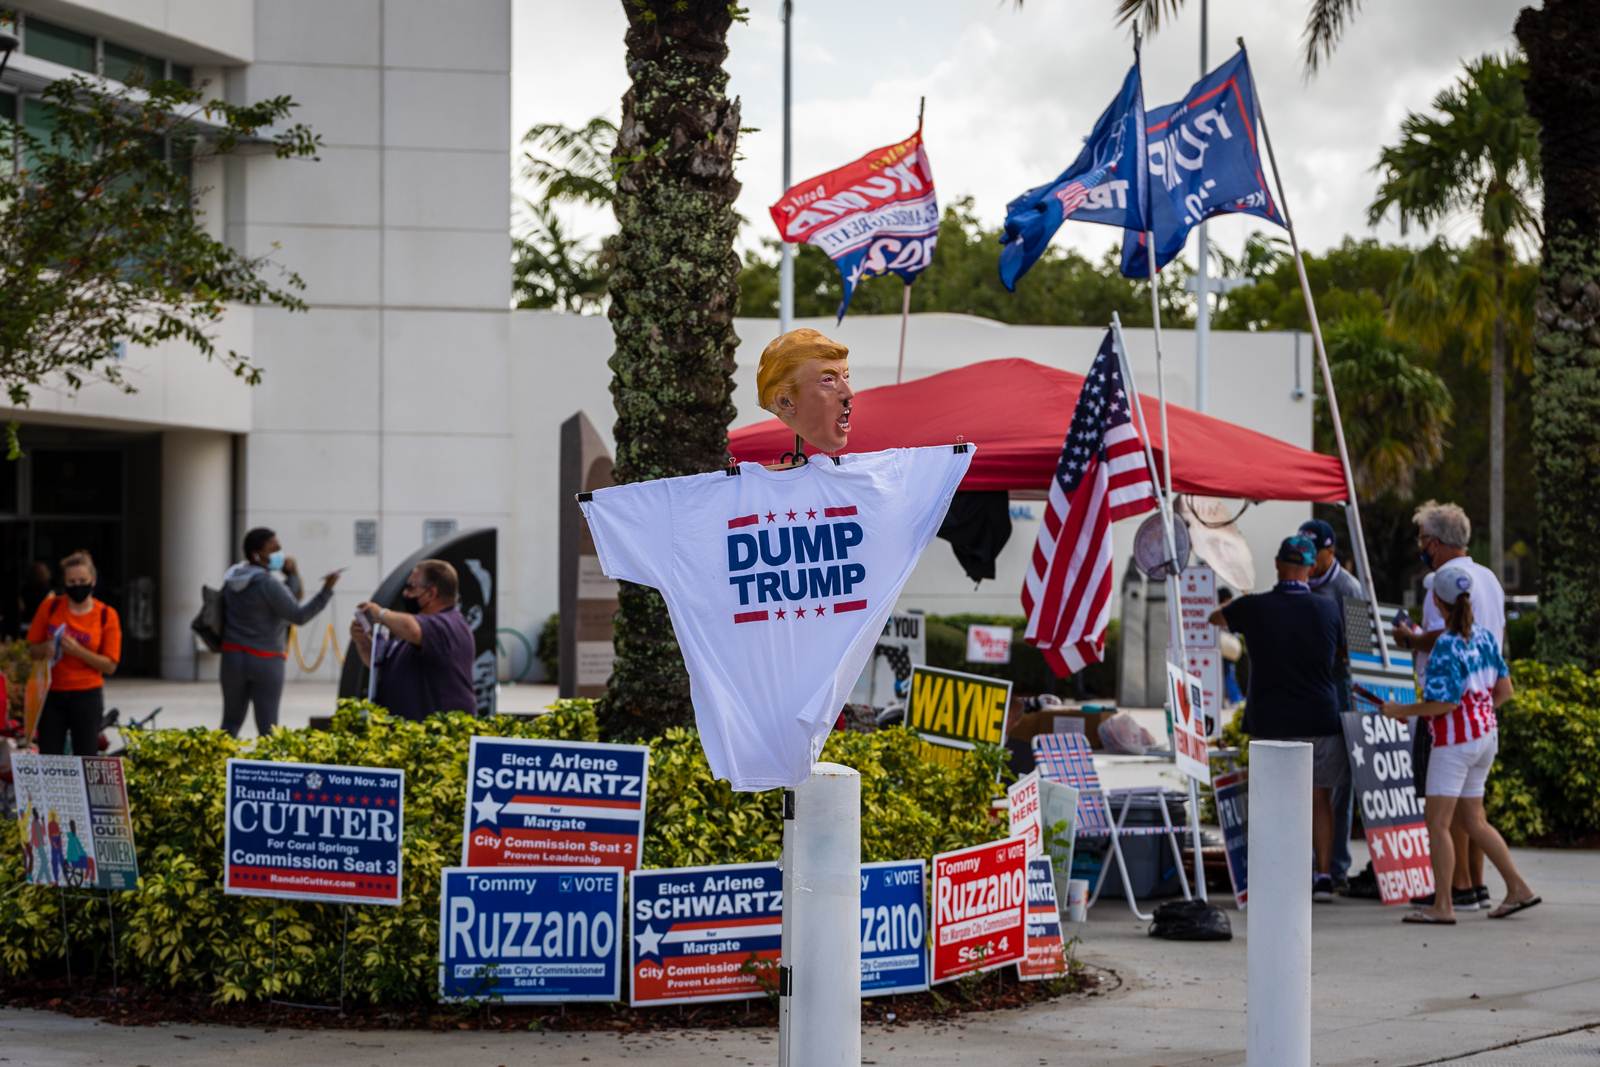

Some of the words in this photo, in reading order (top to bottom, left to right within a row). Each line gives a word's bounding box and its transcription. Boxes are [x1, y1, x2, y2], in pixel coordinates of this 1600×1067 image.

[727, 521, 864, 572] DUMP
[729, 563, 866, 606] TRUMP
[893, 617, 919, 639] YOU
[912, 672, 1007, 744] WAYNE
[1362, 714, 1411, 747] SAVE
[17, 767, 38, 775] YOU
[41, 768, 80, 777] VOTED!
[502, 753, 542, 767] Elect
[549, 752, 618, 771] Arlene
[1373, 750, 1413, 782] OUR
[328, 774, 352, 786] Vote
[354, 777, 377, 787] Nov.
[379, 777, 398, 788] 3rd
[475, 767, 641, 796] SCHWARTZ
[235, 785, 291, 802] Randal
[1011, 782, 1038, 806] VOTE
[1362, 787, 1425, 820] COUNT
[232, 800, 397, 843] CUTTER
[1012, 797, 1039, 825] HERE
[523, 815, 586, 831] Margate
[267, 838, 285, 849] For
[287, 840, 316, 851] Coral
[318, 842, 360, 855] Springs
[474, 835, 501, 849] City
[505, 836, 586, 851] Commission
[590, 841, 620, 853] Seat
[624, 843, 633, 854] 2
[1385, 825, 1430, 861] VOTE
[232, 849, 339, 871] Commission
[343, 857, 382, 873] Seat
[386, 860, 397, 875] 3
[503, 851, 540, 861] Proven
[542, 852, 602, 865] Leadership
[939, 856, 981, 876] Tommy
[1007, 844, 1025, 859] VOTE
[270, 874, 356, 888] RandalCutter.com
[467, 875, 537, 895] Tommy
[575, 877, 613, 892] VOTE
[658, 882, 695, 895] Elect
[703, 876, 765, 893] Arlene
[894, 870, 920, 886] VOTE
[1378, 868, 1435, 902] REPUBLI
[636, 890, 783, 920] SCHWARTZ
[937, 868, 1025, 925] Ruzzano
[449, 896, 614, 959] Ruzzano
[683, 940, 740, 954] Margate
[997, 936, 1009, 952] 4
[456, 967, 472, 976] For
[514, 966, 533, 977] City
[535, 965, 603, 976] Commissioner
[639, 967, 664, 978] City
[667, 979, 701, 989] Proven
[704, 974, 757, 986] Leadership
[514, 978, 534, 987] Seat
[536, 978, 545, 987] 4
